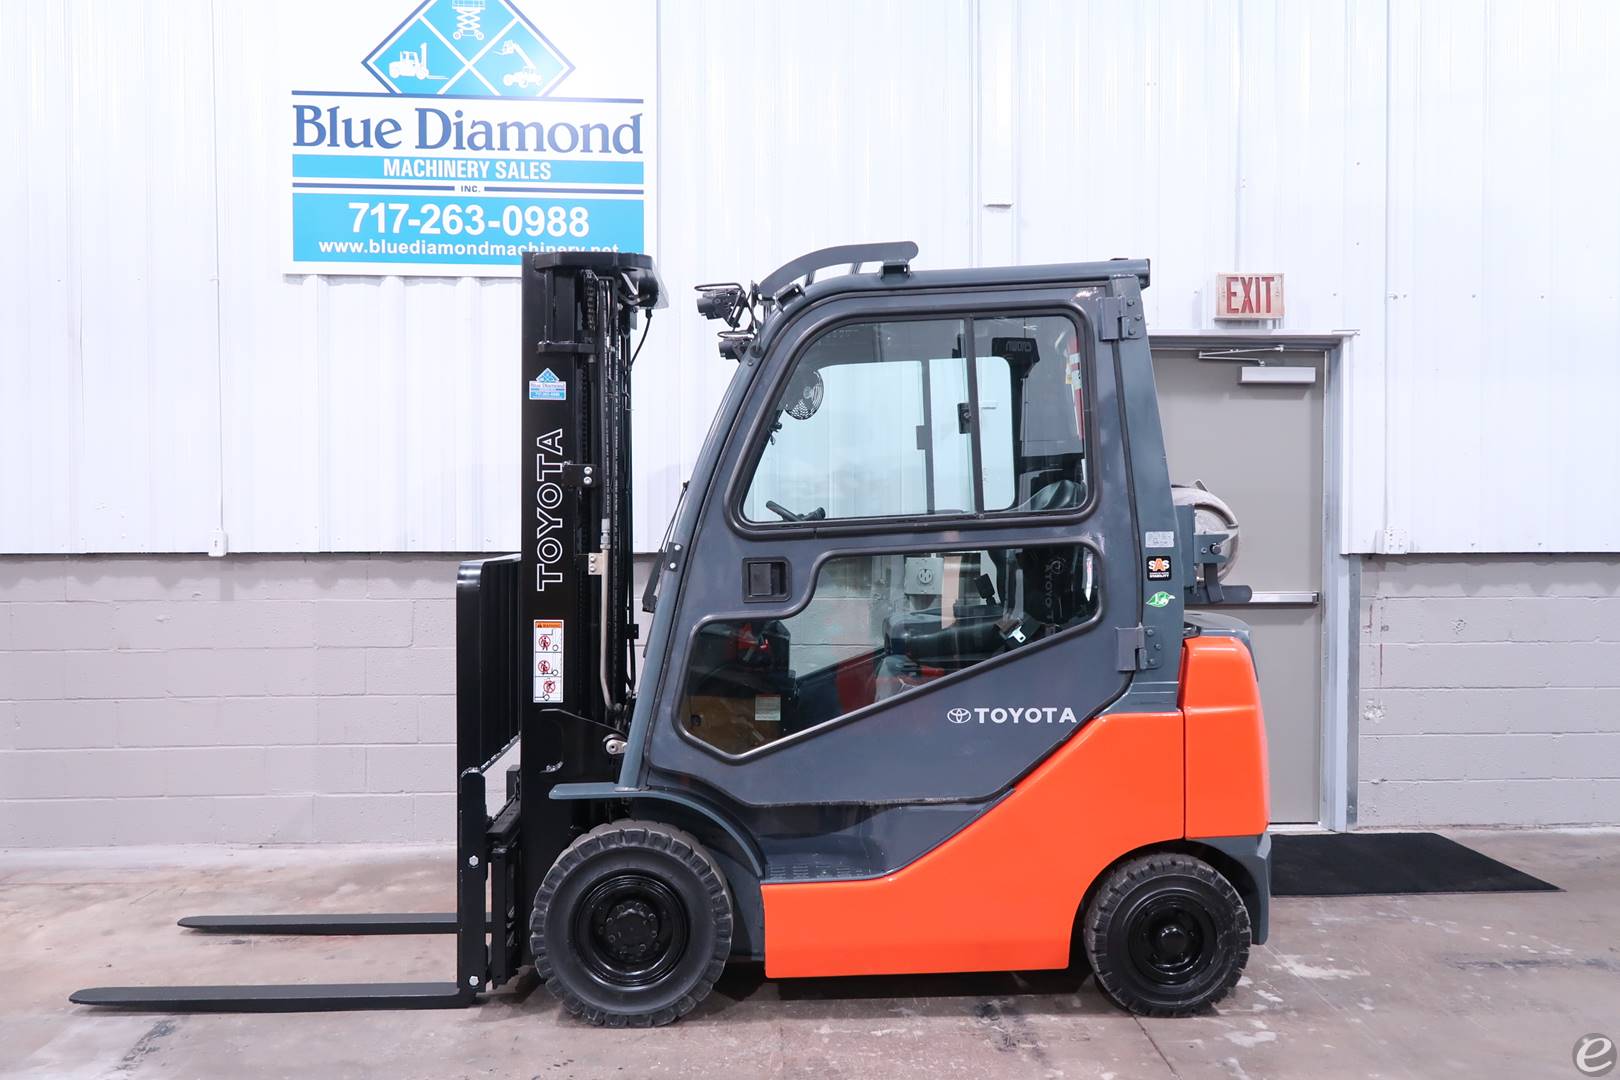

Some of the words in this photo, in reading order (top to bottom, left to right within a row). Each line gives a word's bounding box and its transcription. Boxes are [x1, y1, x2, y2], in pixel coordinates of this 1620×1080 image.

[292, 104, 403, 149] Blue
[414, 107, 644, 154] Diamond
[383, 157, 489, 179] MACHINERY
[495, 160, 552, 181] SALES
[460, 185, 481, 193] INC.
[348, 201, 590, 238] 717-263-0988
[1226, 276, 1274, 314] EXIT
[536, 427, 563, 592] TOYOTA
[1148, 558, 1169, 571] SAS
[974, 707, 1077, 724] TOYOTA
